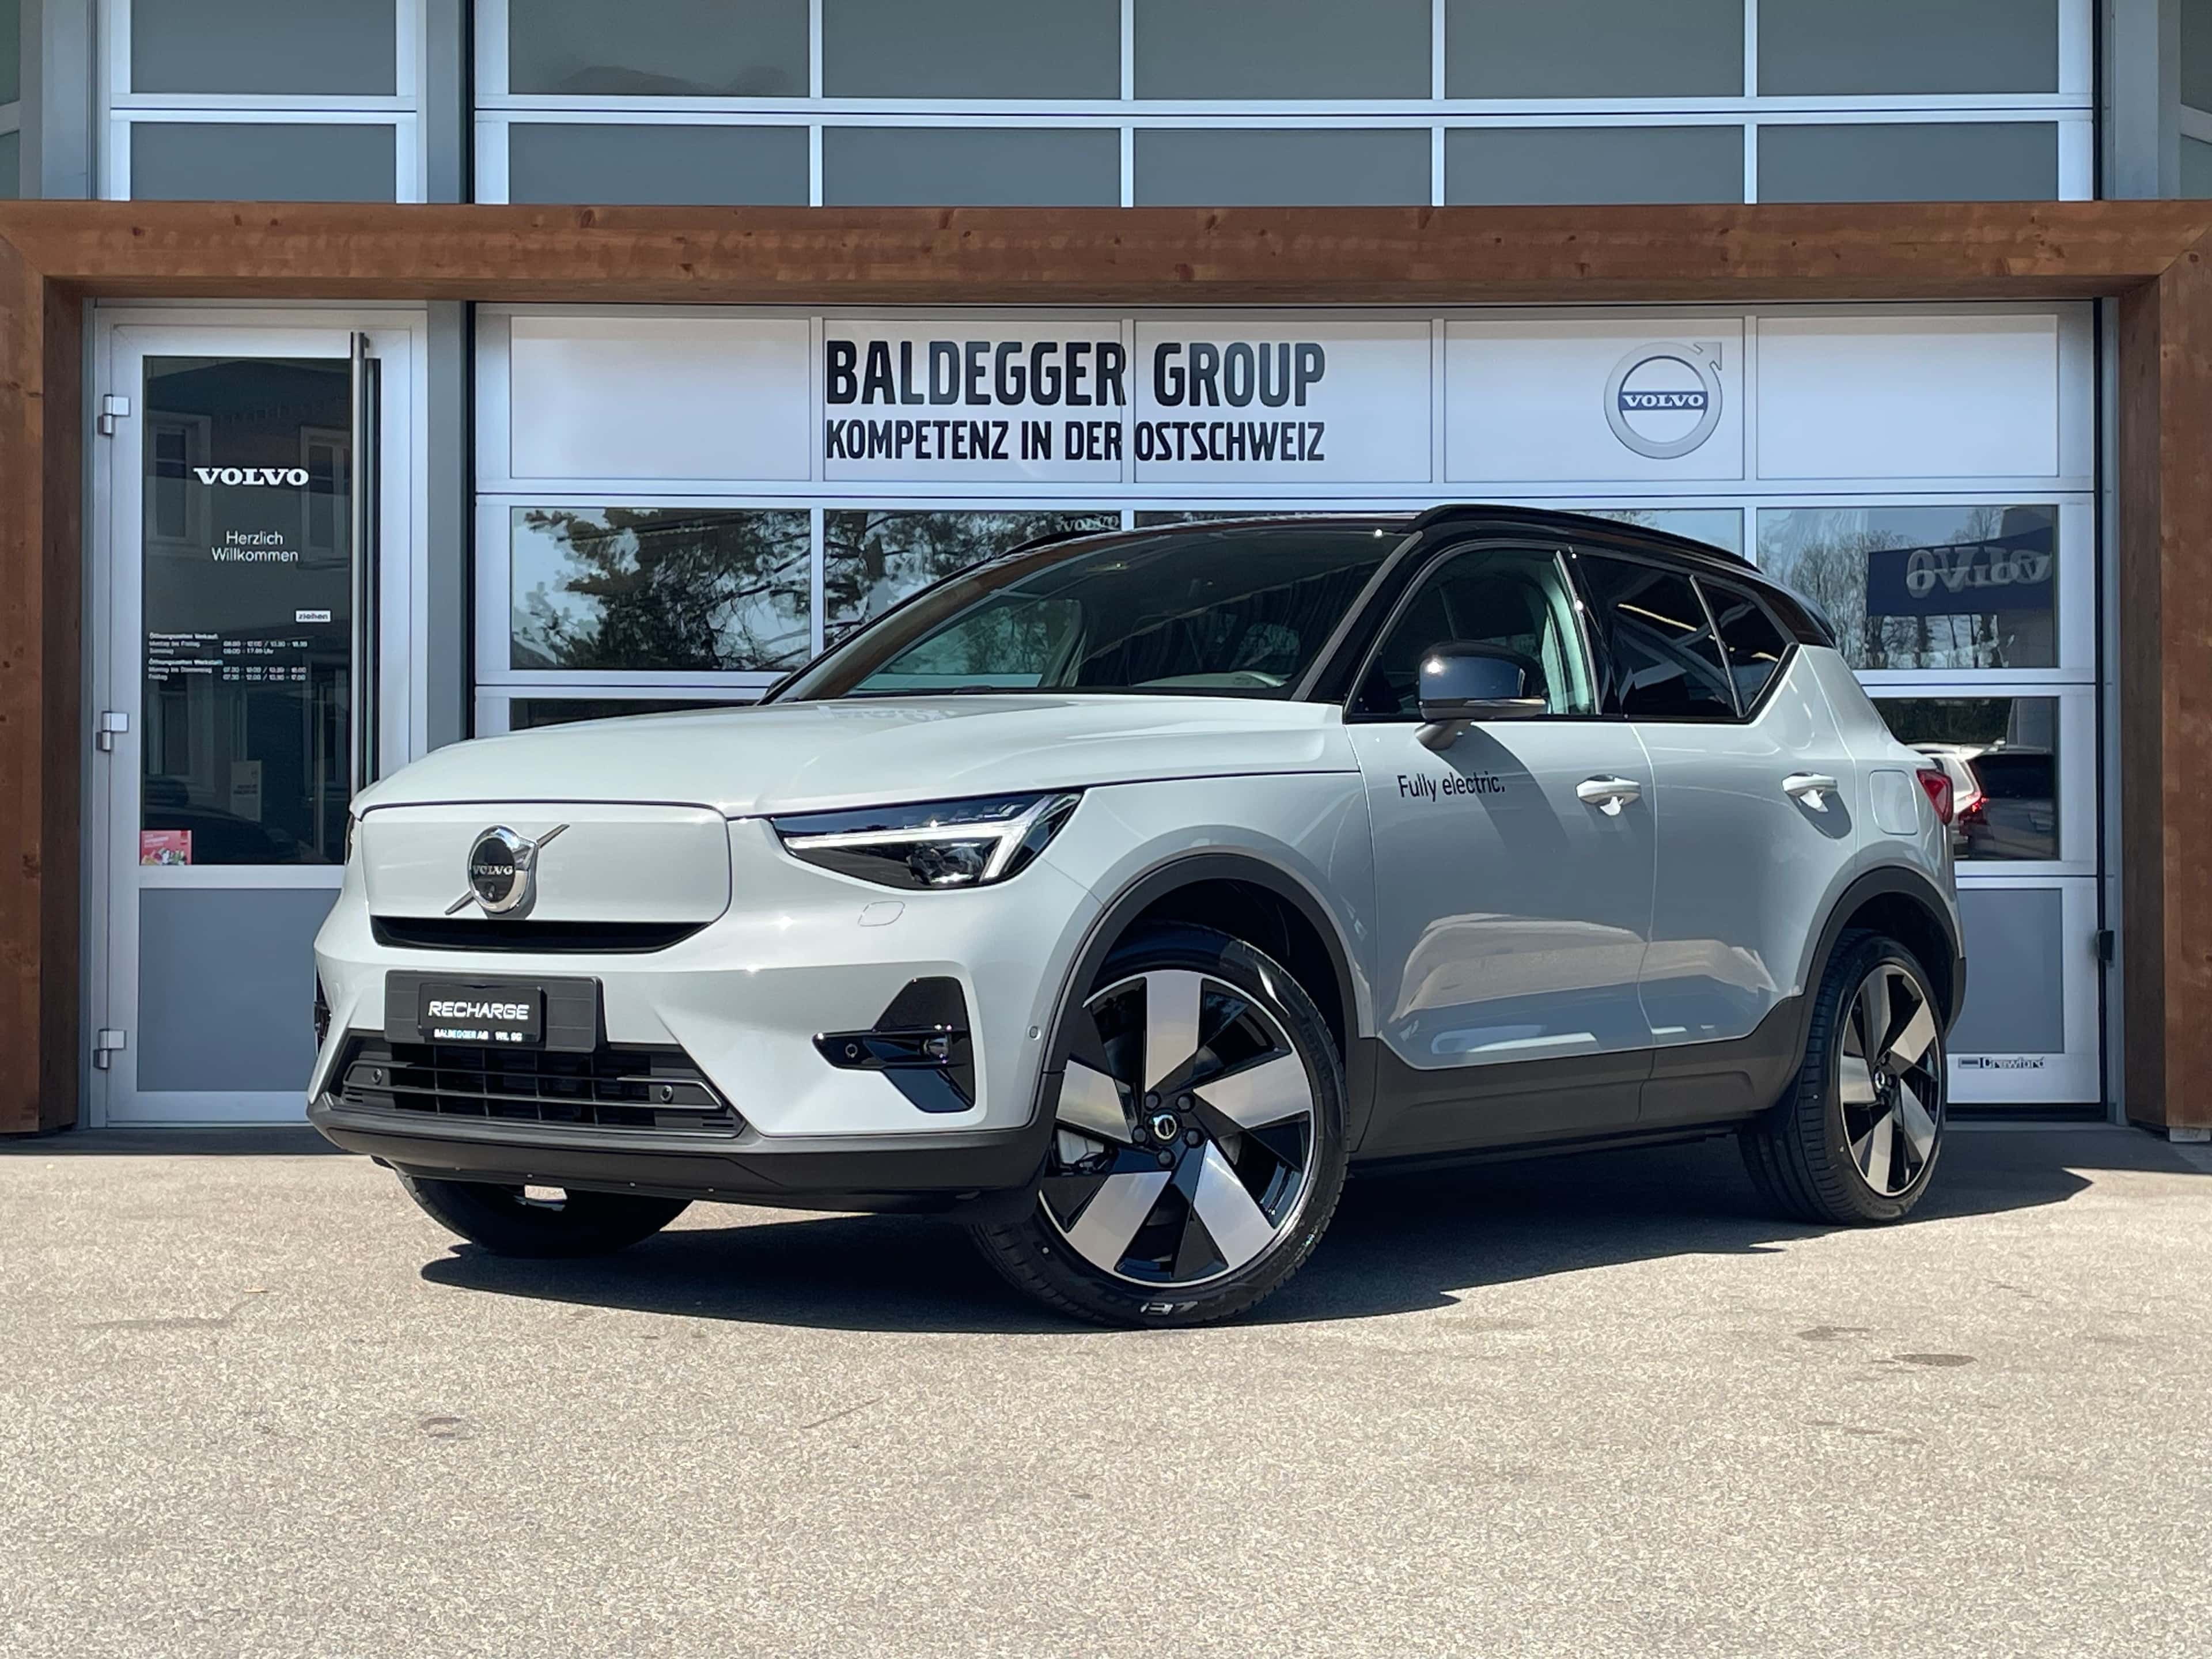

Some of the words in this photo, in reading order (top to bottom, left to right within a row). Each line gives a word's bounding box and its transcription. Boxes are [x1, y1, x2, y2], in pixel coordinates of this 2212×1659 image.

[826, 340, 1127, 407] BALDEGGER
[1154, 342, 1325, 407] GROUP
[1623, 395, 1704, 407] VOLVO
[826, 419, 1009, 460] KOMPETENZ
[1021, 420, 1052, 461] IN
[1065, 420, 1122, 461] DER
[1135, 421, 1325, 462] OSTSCHWEIZ
[194, 468, 309, 486] VOLVO
[226, 531, 284, 545] Herzlich
[211, 548, 299, 562] Willkommen
[1397, 773, 1437, 802] Fully
[1442, 771, 1505, 796] electric.
[472, 865, 513, 875] VOLVO
[427, 1001, 530, 1020] RECHARGE
